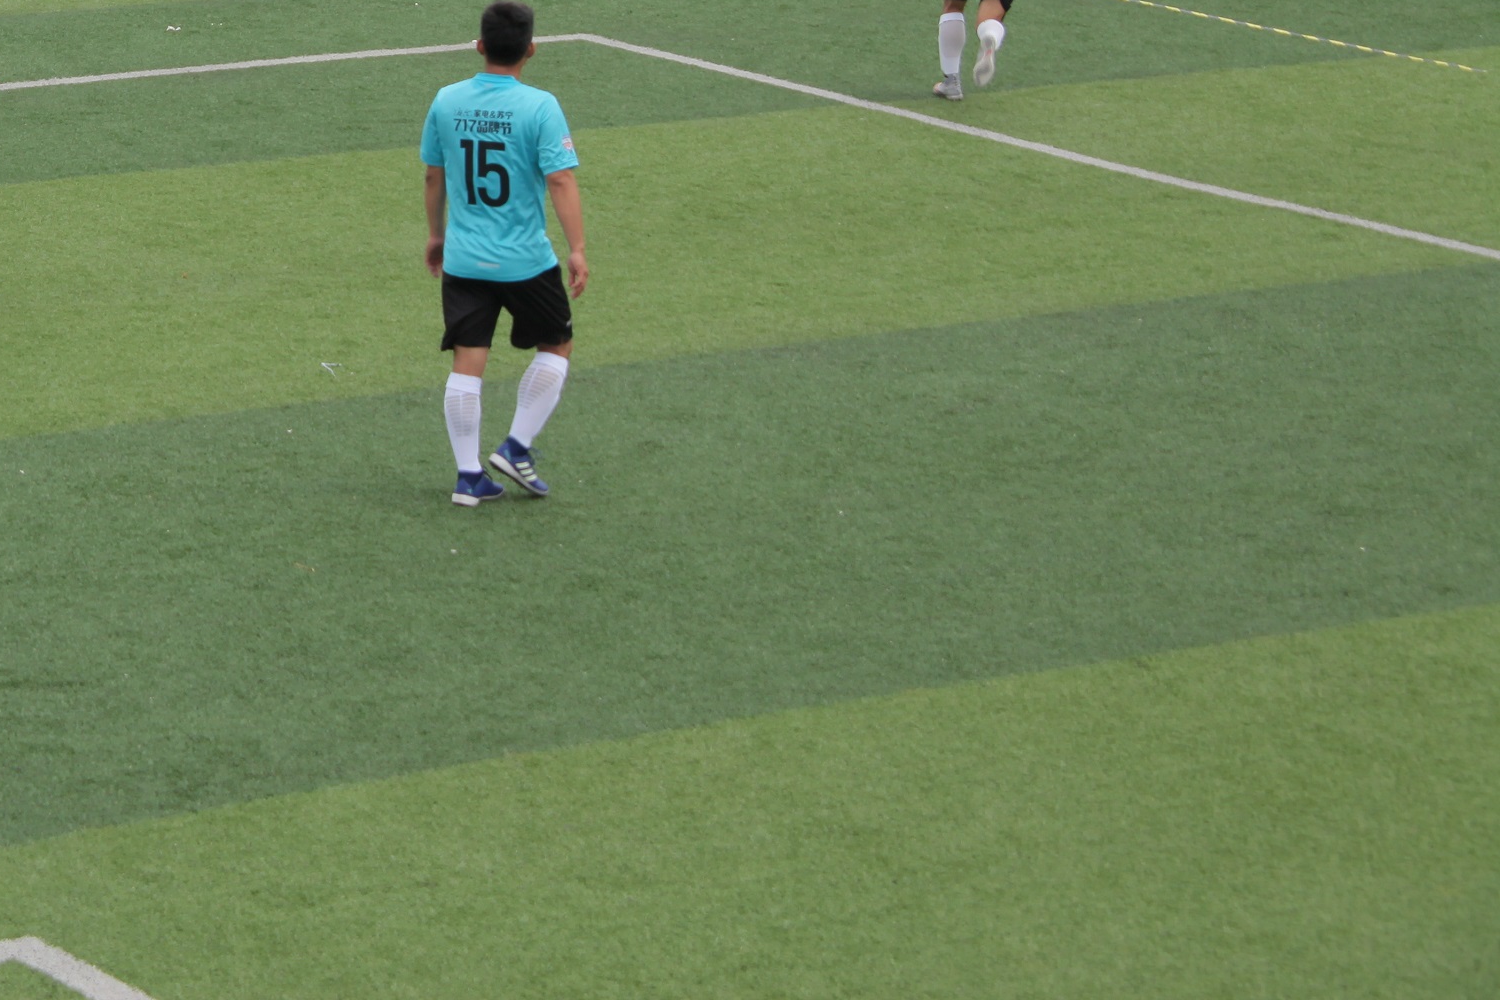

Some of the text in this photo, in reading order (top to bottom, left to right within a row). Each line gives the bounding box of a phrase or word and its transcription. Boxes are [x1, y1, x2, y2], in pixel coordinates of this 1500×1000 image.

[453, 118, 512, 135] 717品牌节
[460, 139, 510, 207] 15
